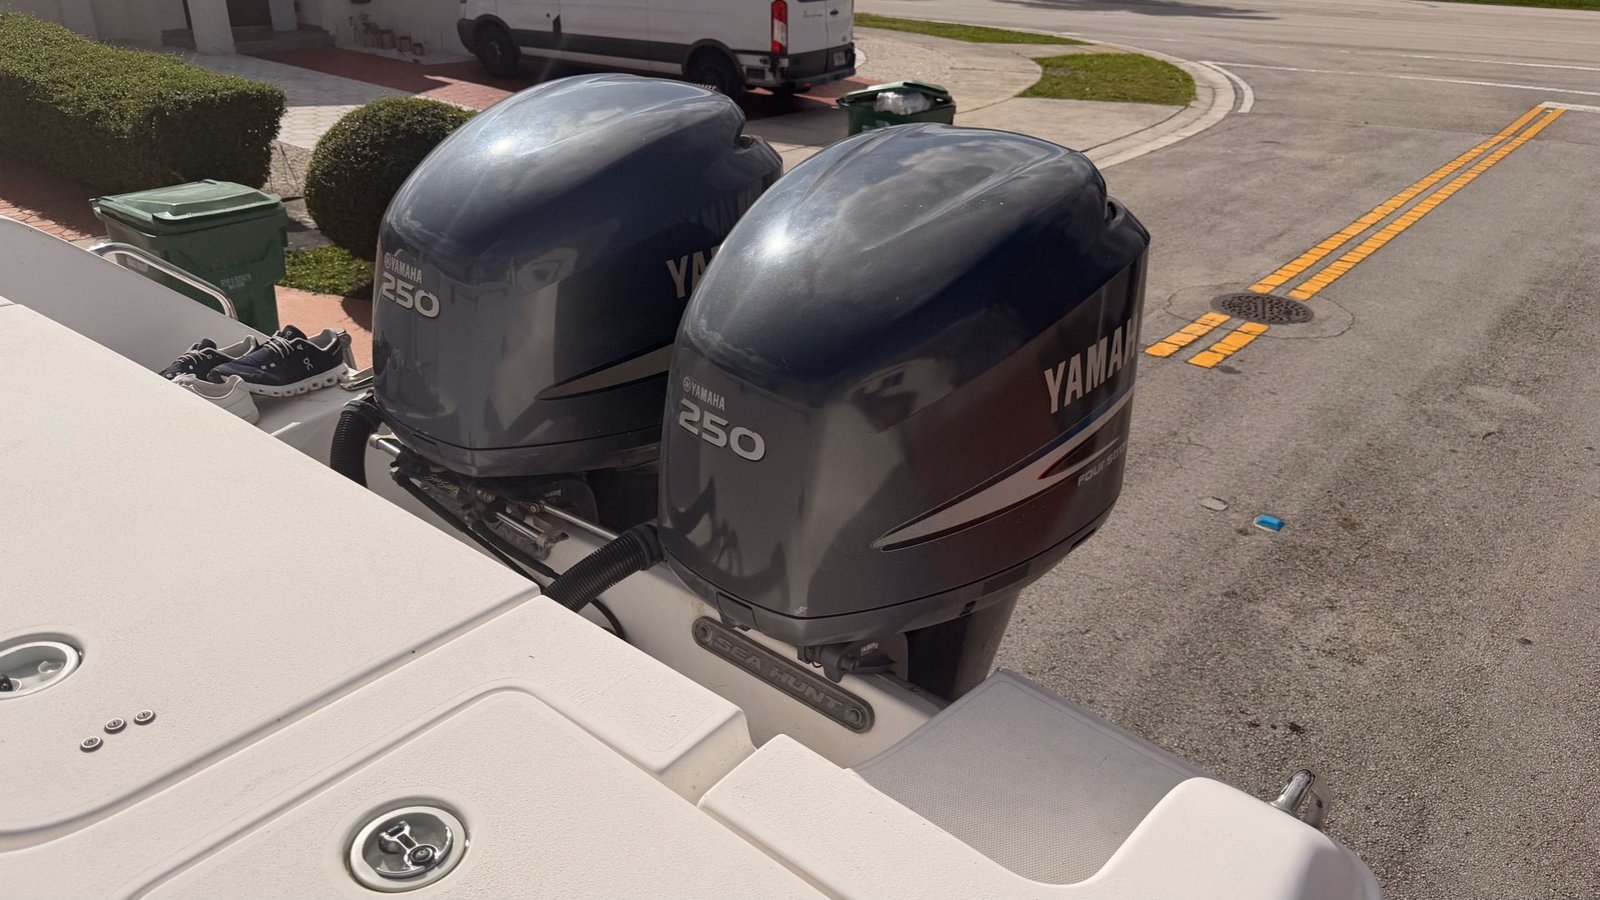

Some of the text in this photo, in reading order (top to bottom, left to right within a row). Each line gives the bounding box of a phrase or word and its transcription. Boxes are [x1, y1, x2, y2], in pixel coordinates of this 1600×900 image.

[382, 271, 439, 318] 250
[391, 257, 422, 284] YAMAHA
[665, 245, 720, 298] YA
[691, 381, 725, 411] YAMAHA
[679, 398, 765, 461] 250
[712, 637, 843, 711] SEA HUNT
